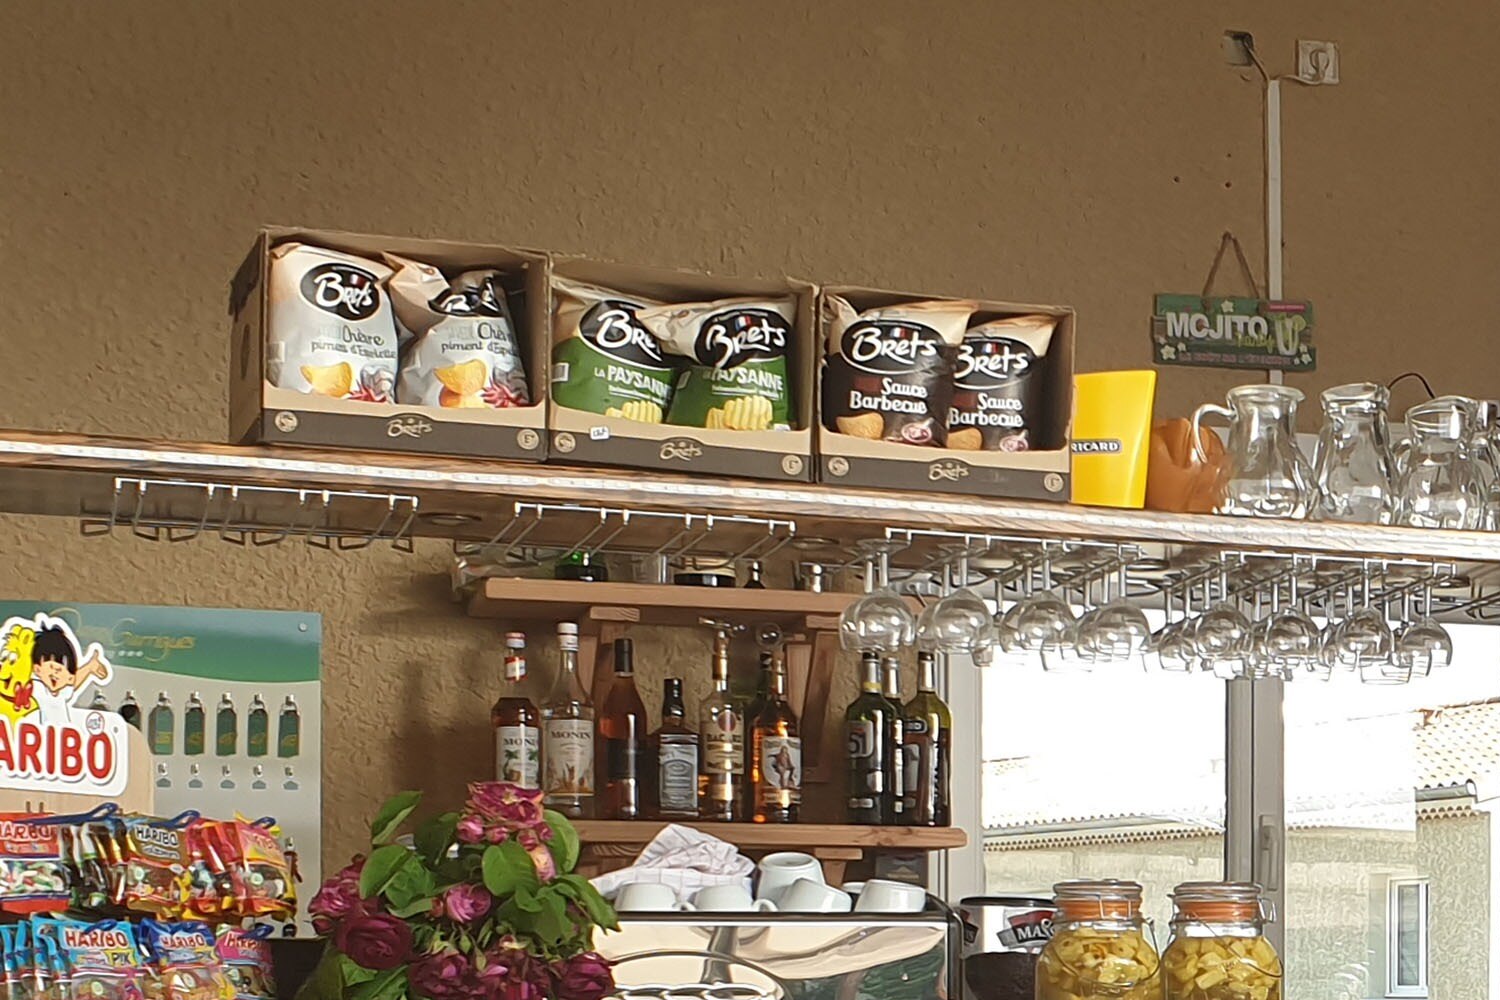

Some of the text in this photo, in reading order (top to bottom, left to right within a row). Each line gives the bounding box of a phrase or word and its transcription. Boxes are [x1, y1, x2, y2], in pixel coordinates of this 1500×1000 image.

[1165, 311, 1268, 341] MOJITO
[705, 316, 786, 368] Brets
[852, 328, 938, 366] Brets
[881, 377, 929, 398] Sauce
[849, 390, 928, 415] Barbecue
[977, 392, 1023, 412] Sauce
[948, 407, 1025, 428] Barbecue
[136, 825, 179, 846] HARIBO
[65, 930, 128, 949] HARIBO
[161, 933, 205, 949] HARIBO
